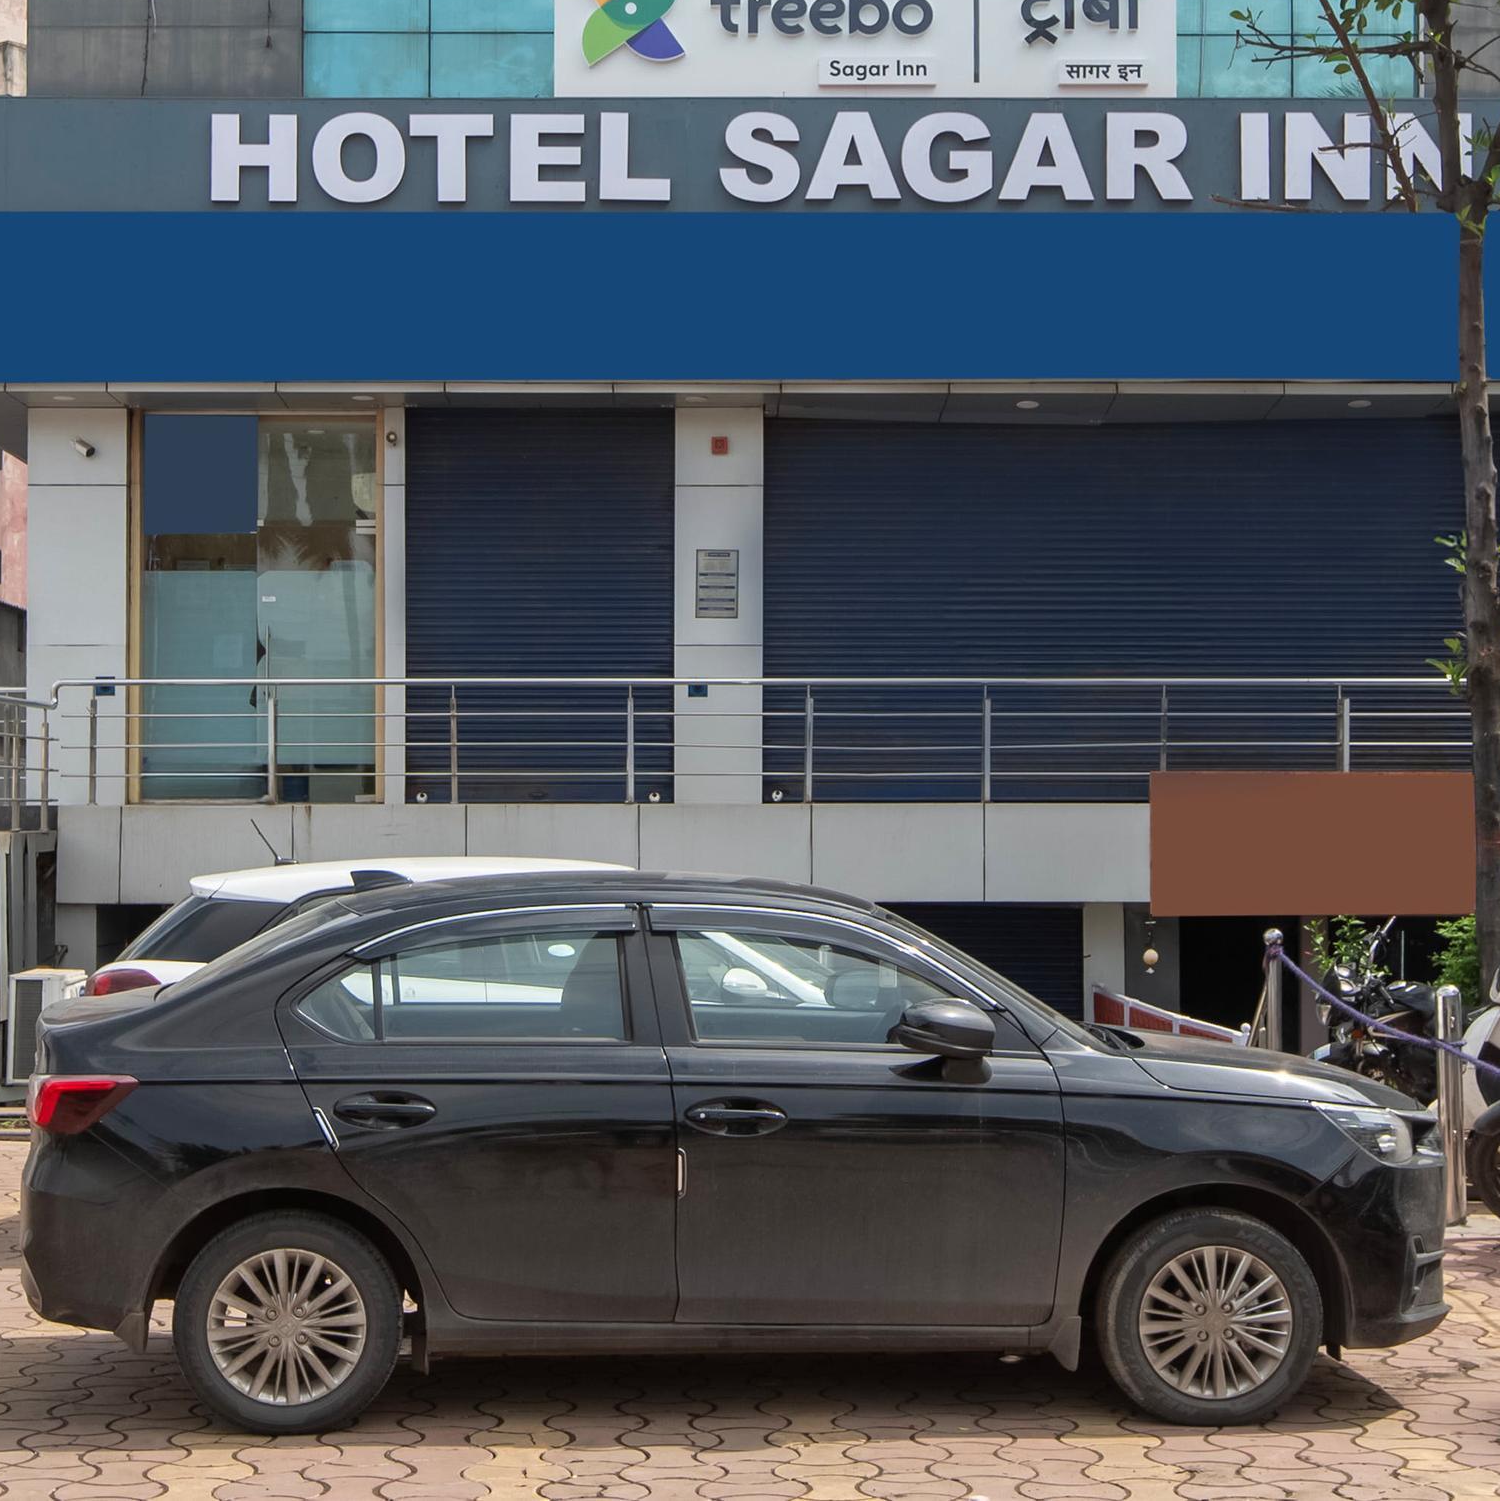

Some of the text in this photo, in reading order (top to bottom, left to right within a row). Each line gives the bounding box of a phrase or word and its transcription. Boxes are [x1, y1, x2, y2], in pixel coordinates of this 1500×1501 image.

[829, 59, 928, 82] Sagar Inn
[1065, 61, 1143, 82] सागर इन
[211, 111, 1473, 203] HOTEL SAGAR INN
